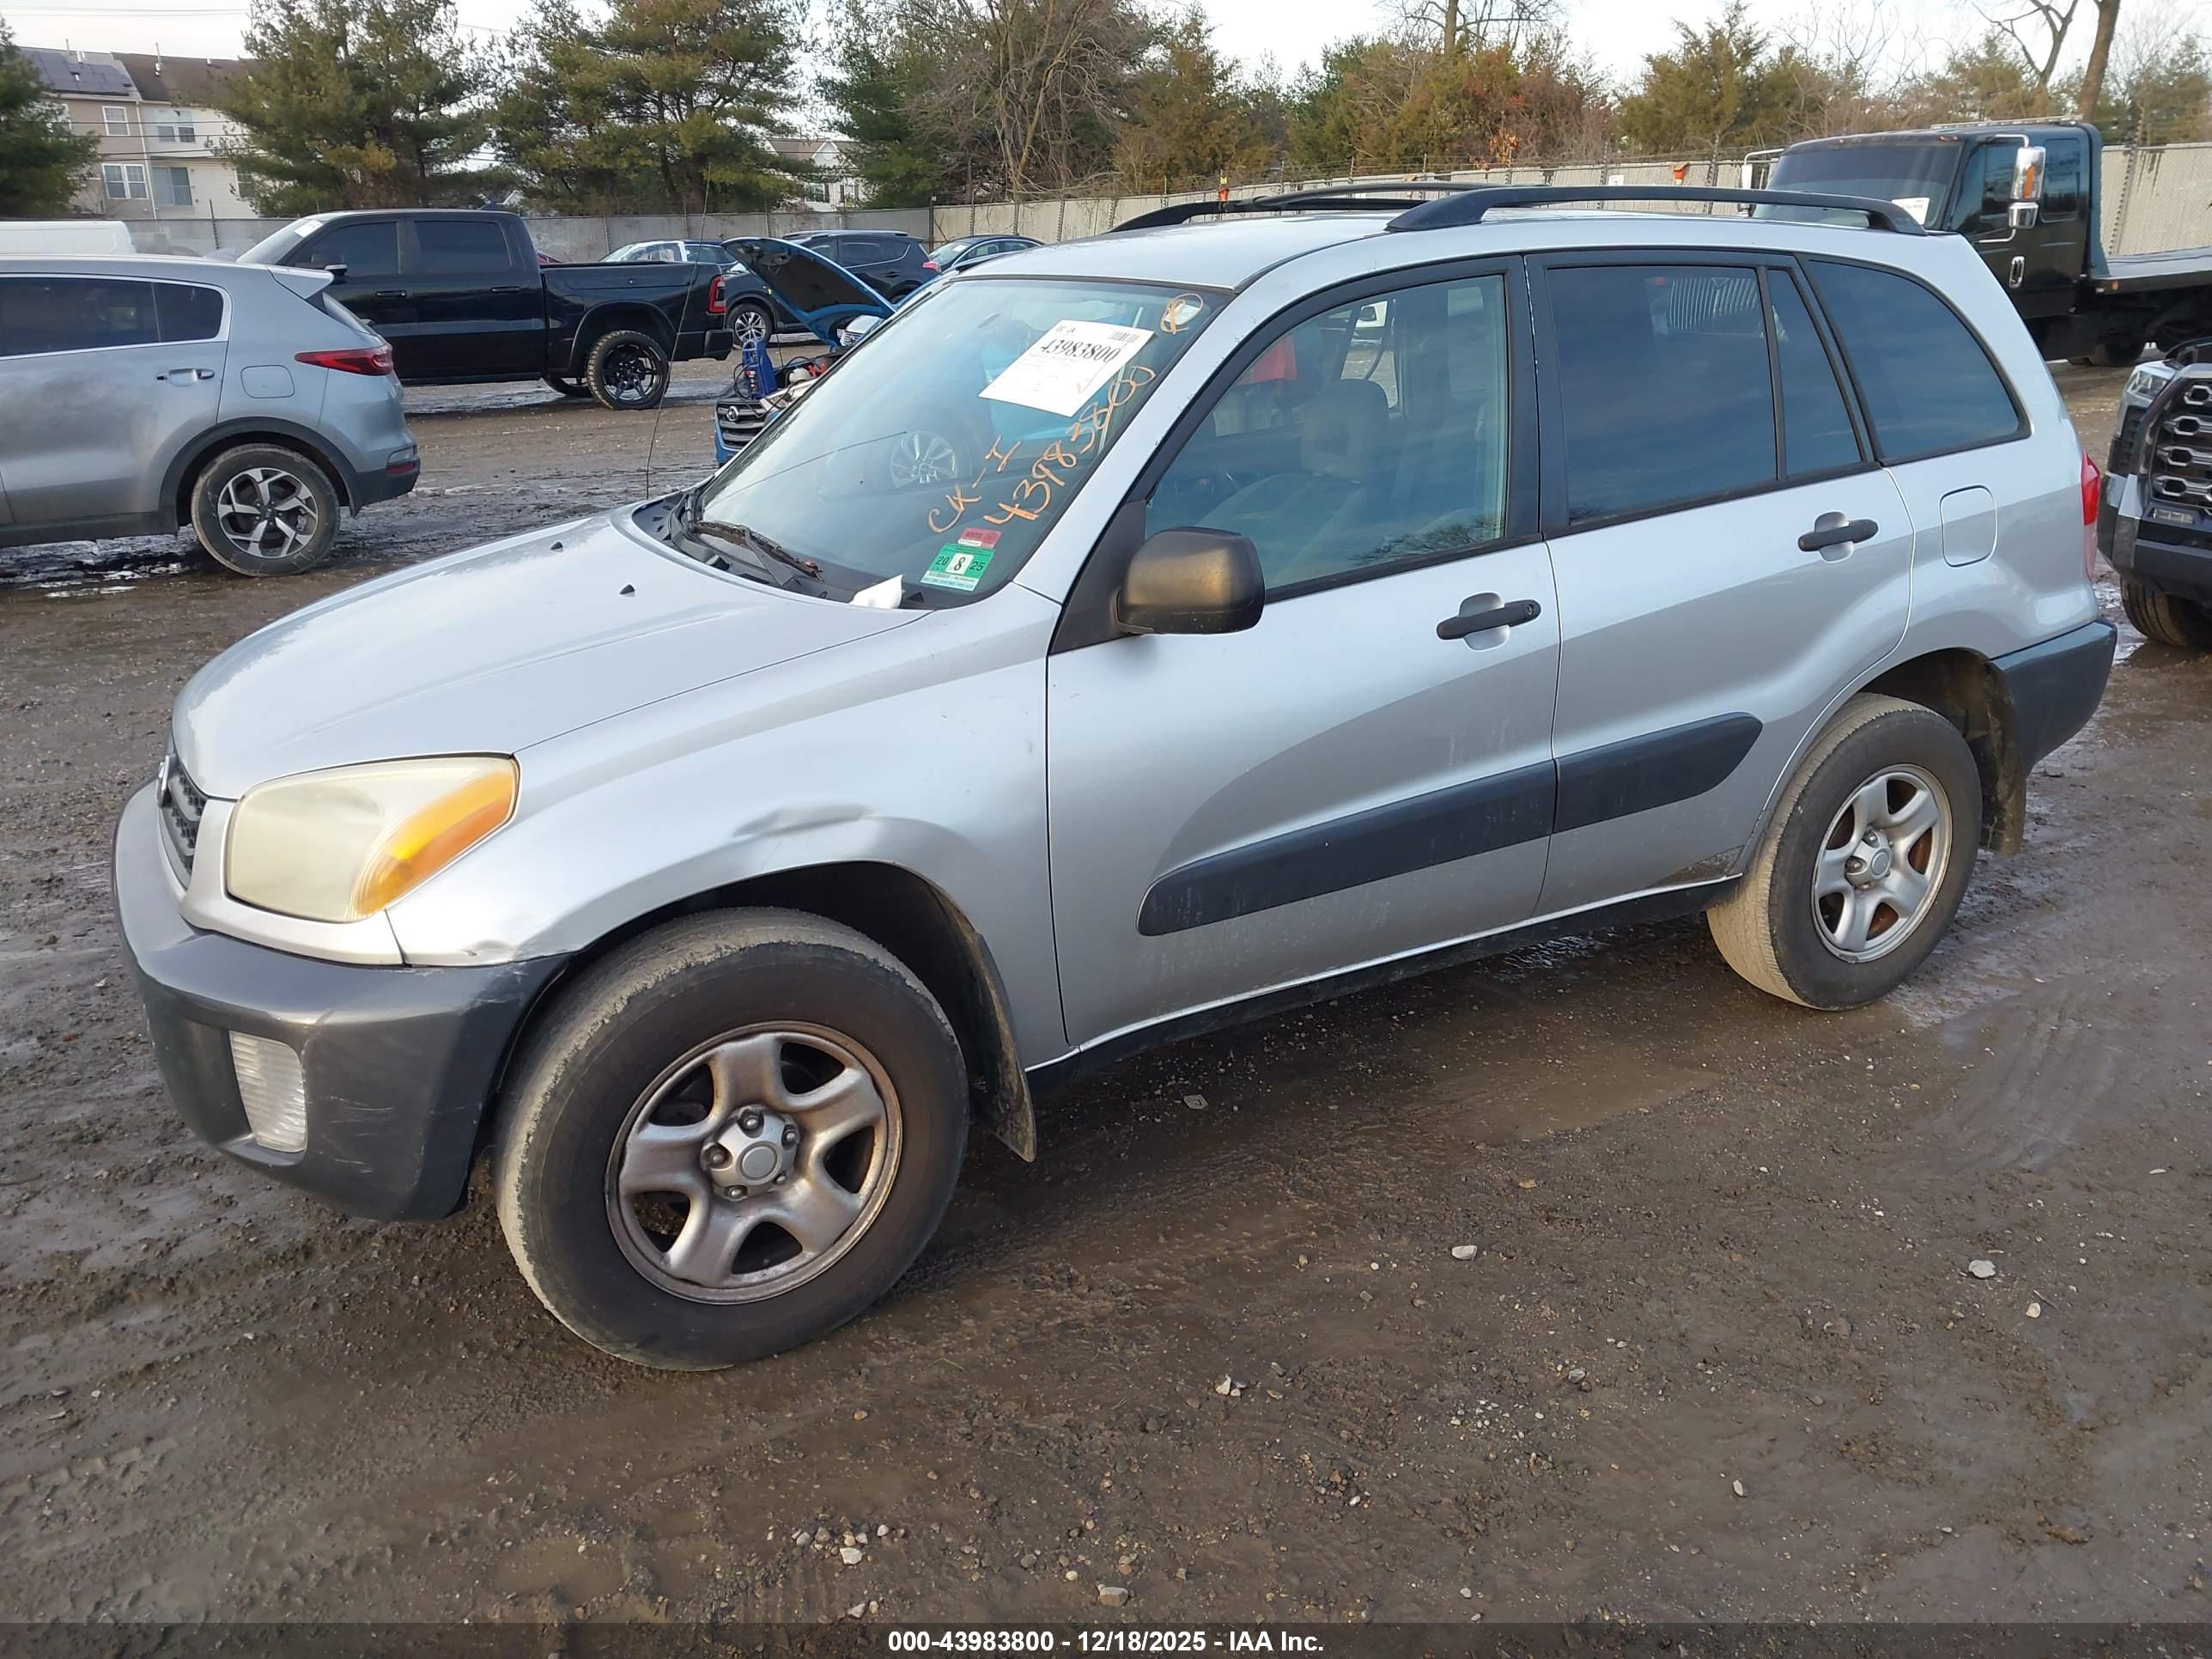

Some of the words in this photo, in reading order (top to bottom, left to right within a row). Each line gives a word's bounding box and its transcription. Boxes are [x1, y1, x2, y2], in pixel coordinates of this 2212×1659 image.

[1041, 338, 1121, 362] 43983800
[935, 556, 950, 566] 20
[953, 556, 966, 571] 8
[969, 561, 986, 571] 25
